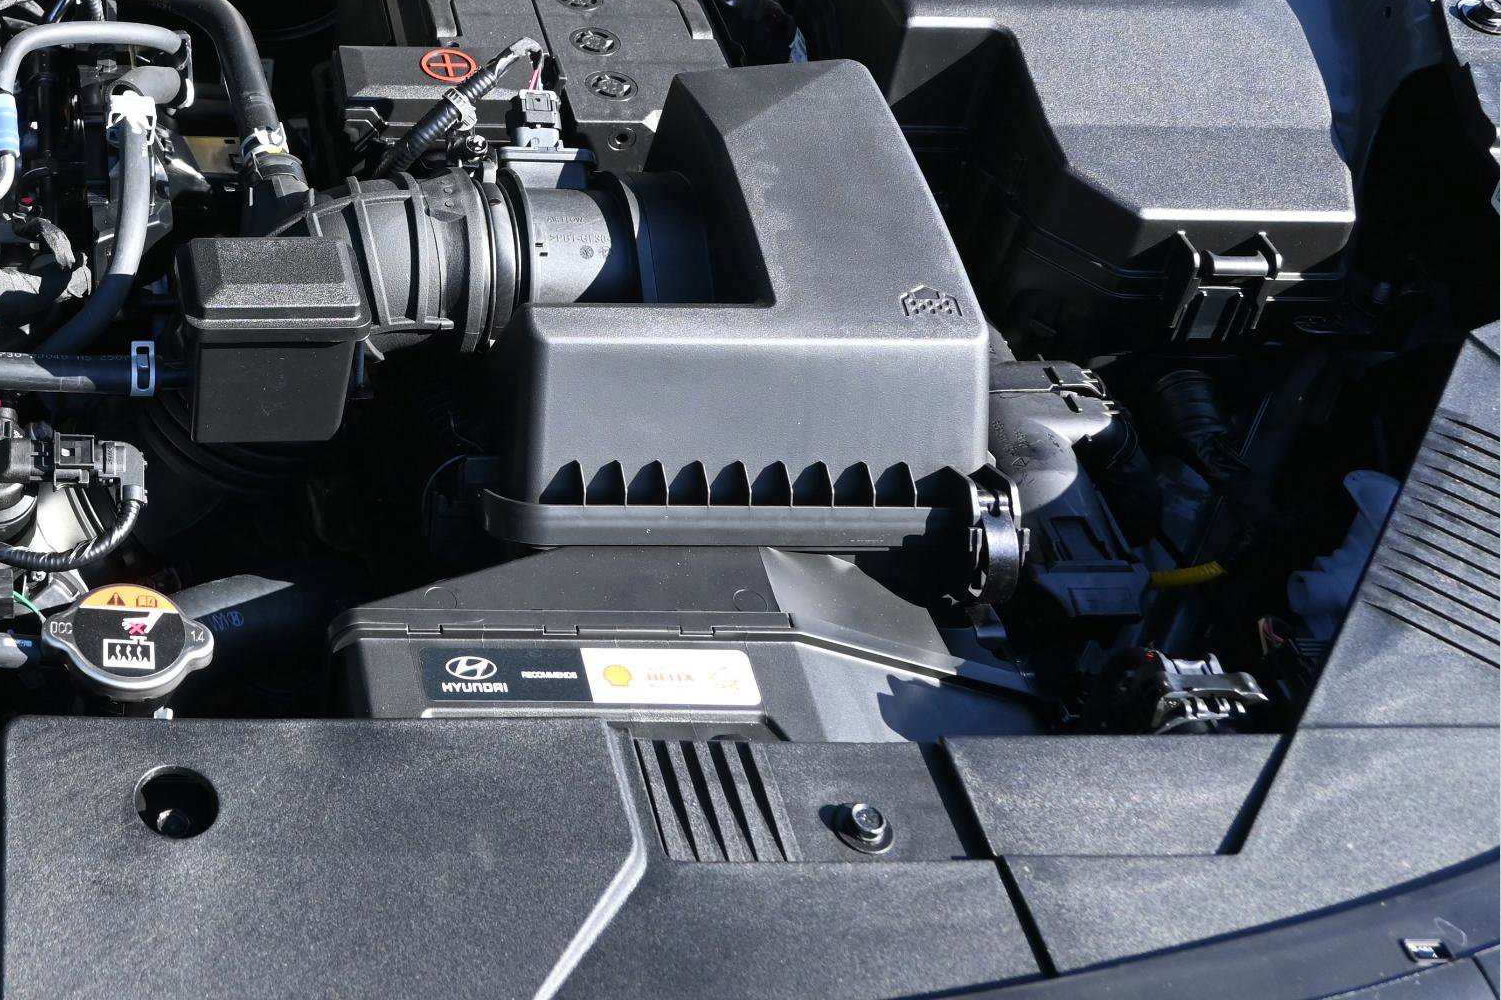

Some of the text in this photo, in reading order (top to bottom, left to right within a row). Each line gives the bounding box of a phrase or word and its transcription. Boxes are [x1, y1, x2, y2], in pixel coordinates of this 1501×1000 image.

[521, 670, 578, 679] RECOMMENDS
[647, 673, 697, 682] HELIX
[441, 682, 509, 693] HYUNDAI
